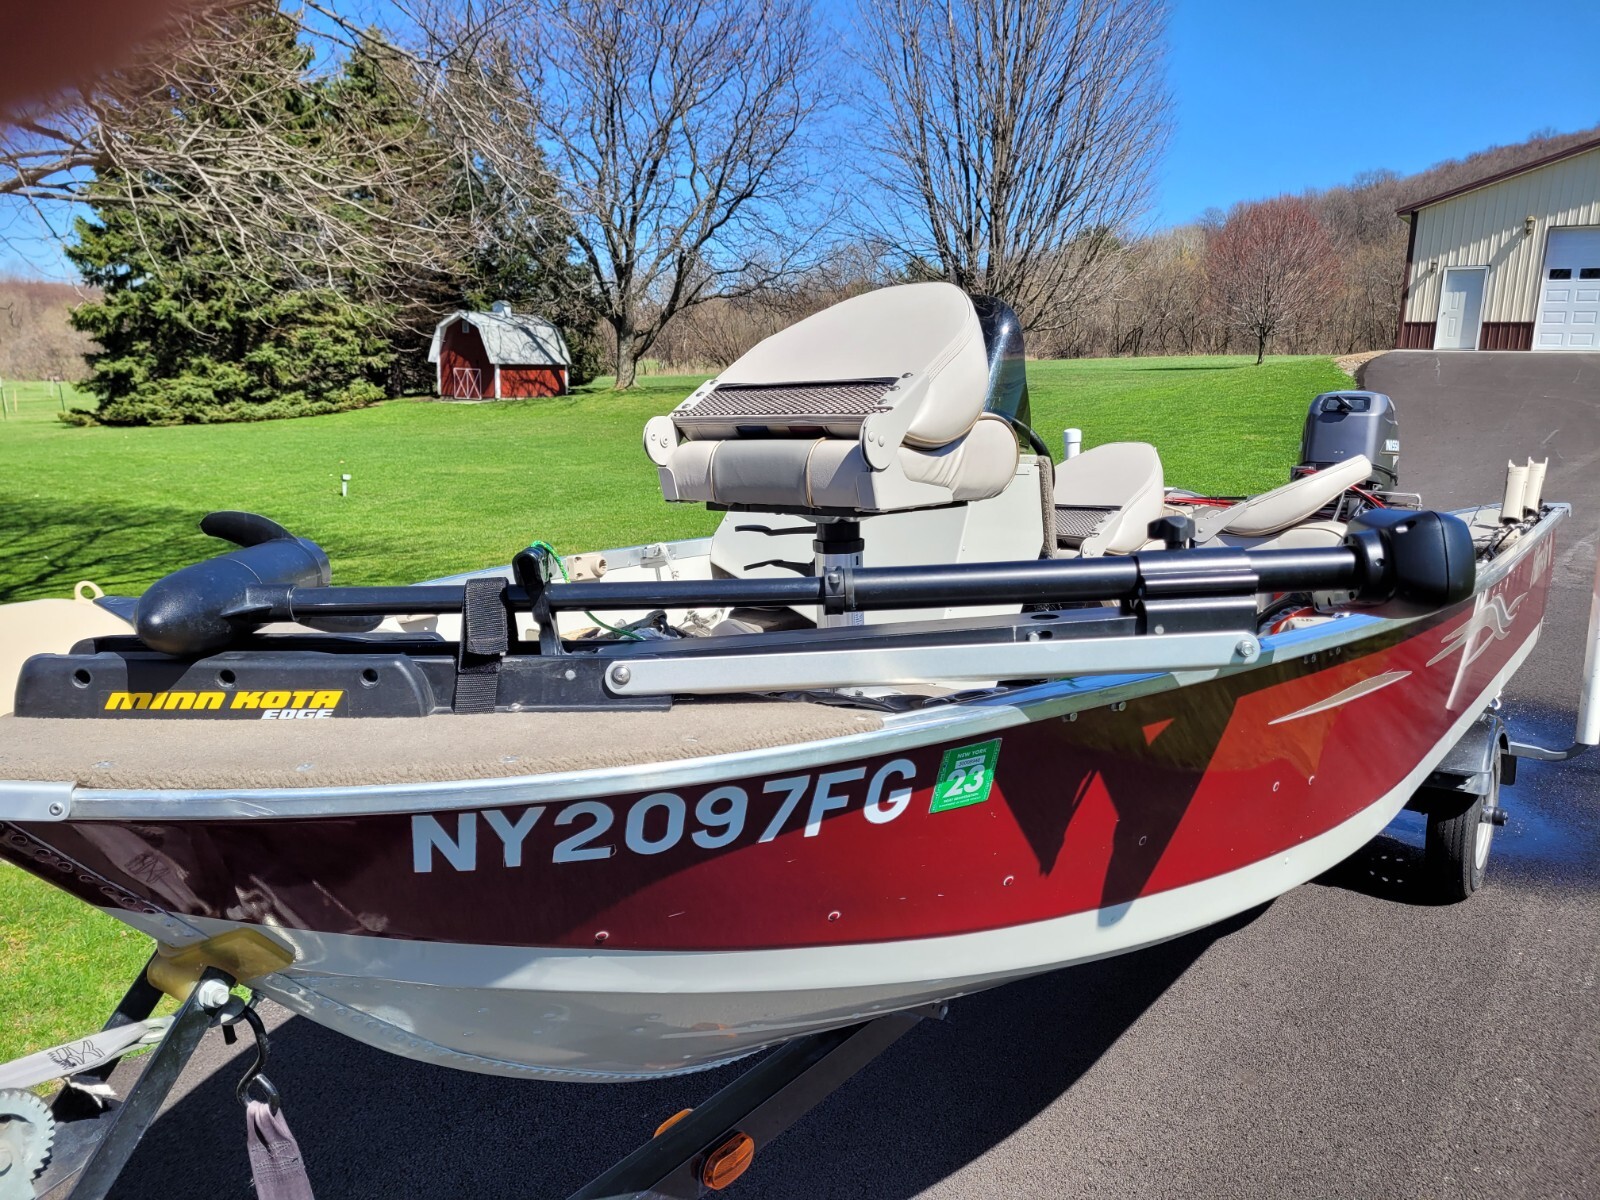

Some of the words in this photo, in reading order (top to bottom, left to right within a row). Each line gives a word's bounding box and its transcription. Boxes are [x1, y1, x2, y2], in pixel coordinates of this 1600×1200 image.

[104, 692, 226, 710] MINN
[229, 690, 344, 709] KOTA
[261, 709, 335, 720] EDGE
[957, 751, 971, 759] NEW
[972, 748, 987, 756] YORK
[942, 764, 985, 798] 23
[411, 758, 917, 873] NY2097FG
